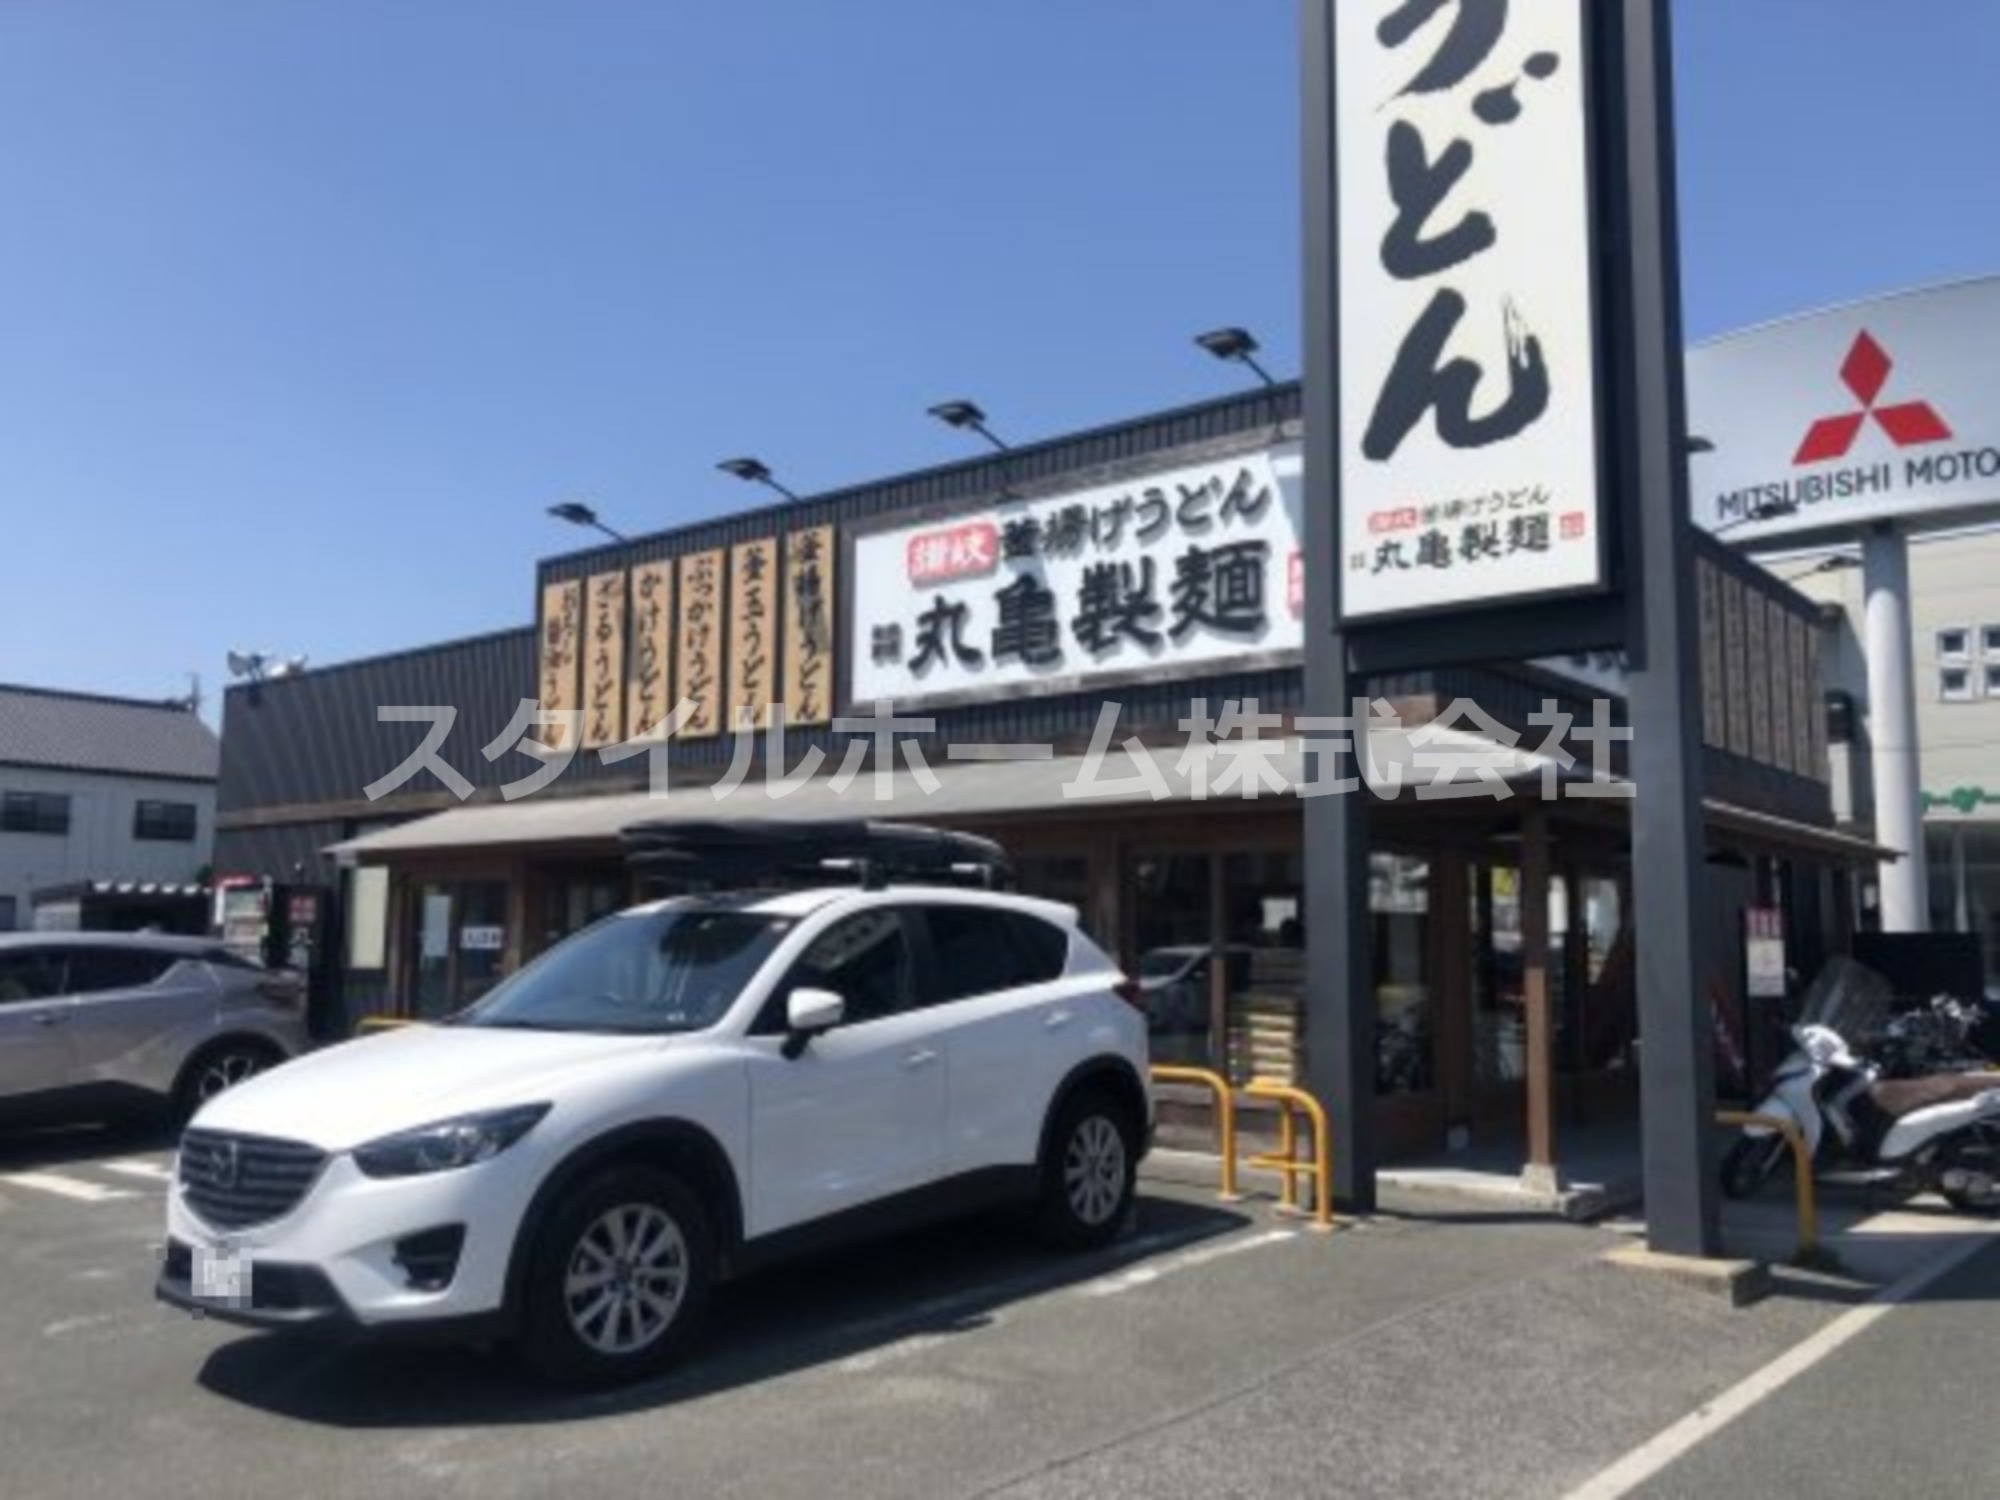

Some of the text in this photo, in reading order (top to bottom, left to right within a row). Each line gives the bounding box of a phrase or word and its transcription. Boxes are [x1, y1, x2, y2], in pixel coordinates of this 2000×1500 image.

[1000, 467, 1270, 562] 釜揚げうどん
[1717, 463, 1890, 519] MITSUBISHI
[908, 539, 1274, 676] 丸亀製麺
